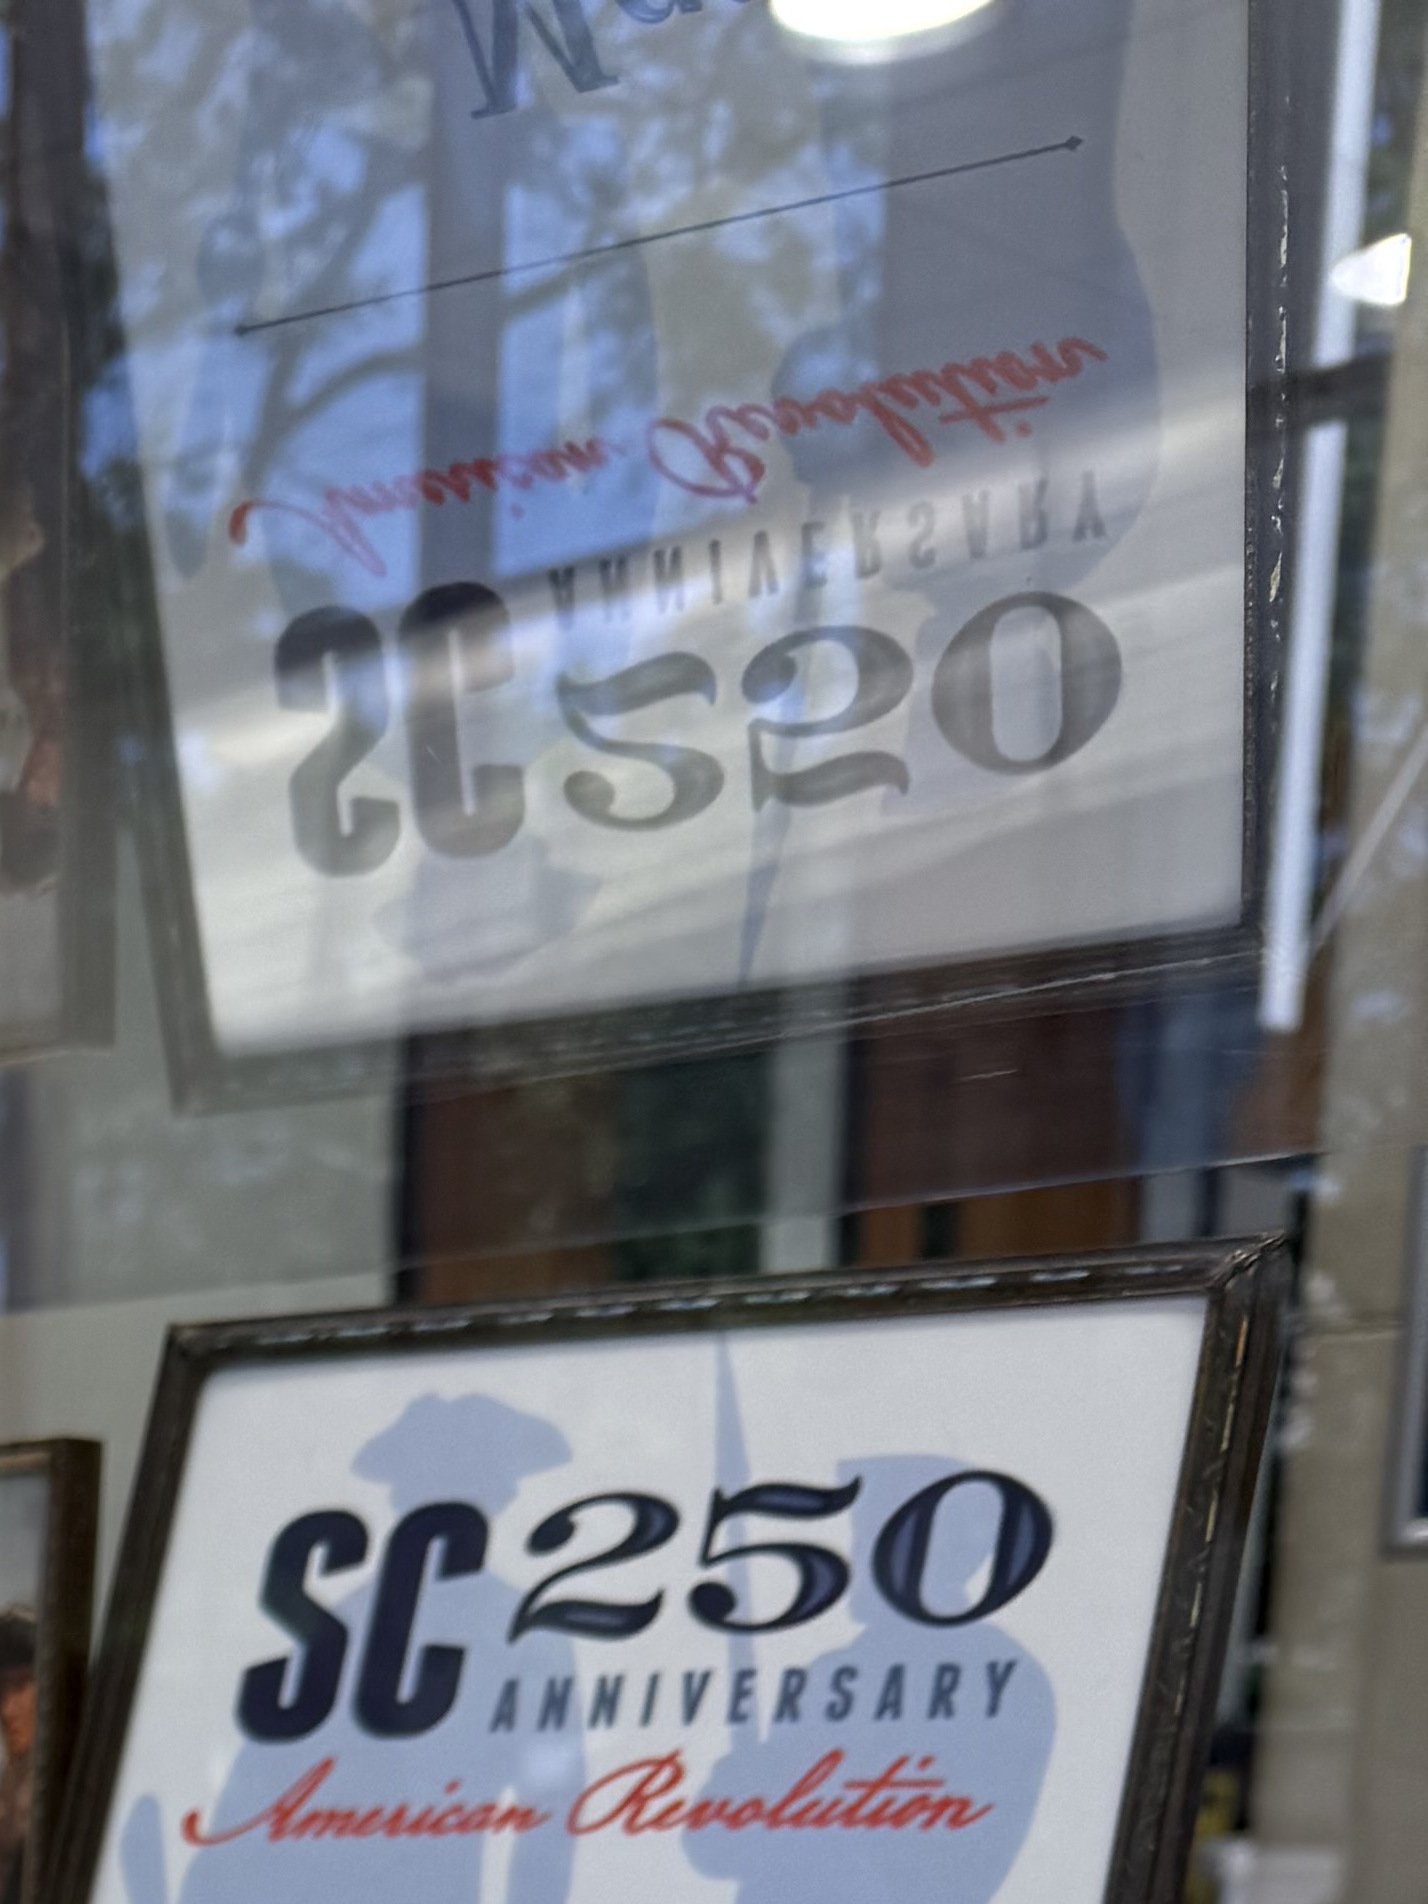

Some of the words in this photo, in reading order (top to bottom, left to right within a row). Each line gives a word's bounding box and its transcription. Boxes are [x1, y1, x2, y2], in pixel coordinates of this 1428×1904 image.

[490, 1658, 1020, 1733] ANNIVERSARY
[182, 1754, 551, 1845] American
[566, 1748, 991, 1839] Revolution
